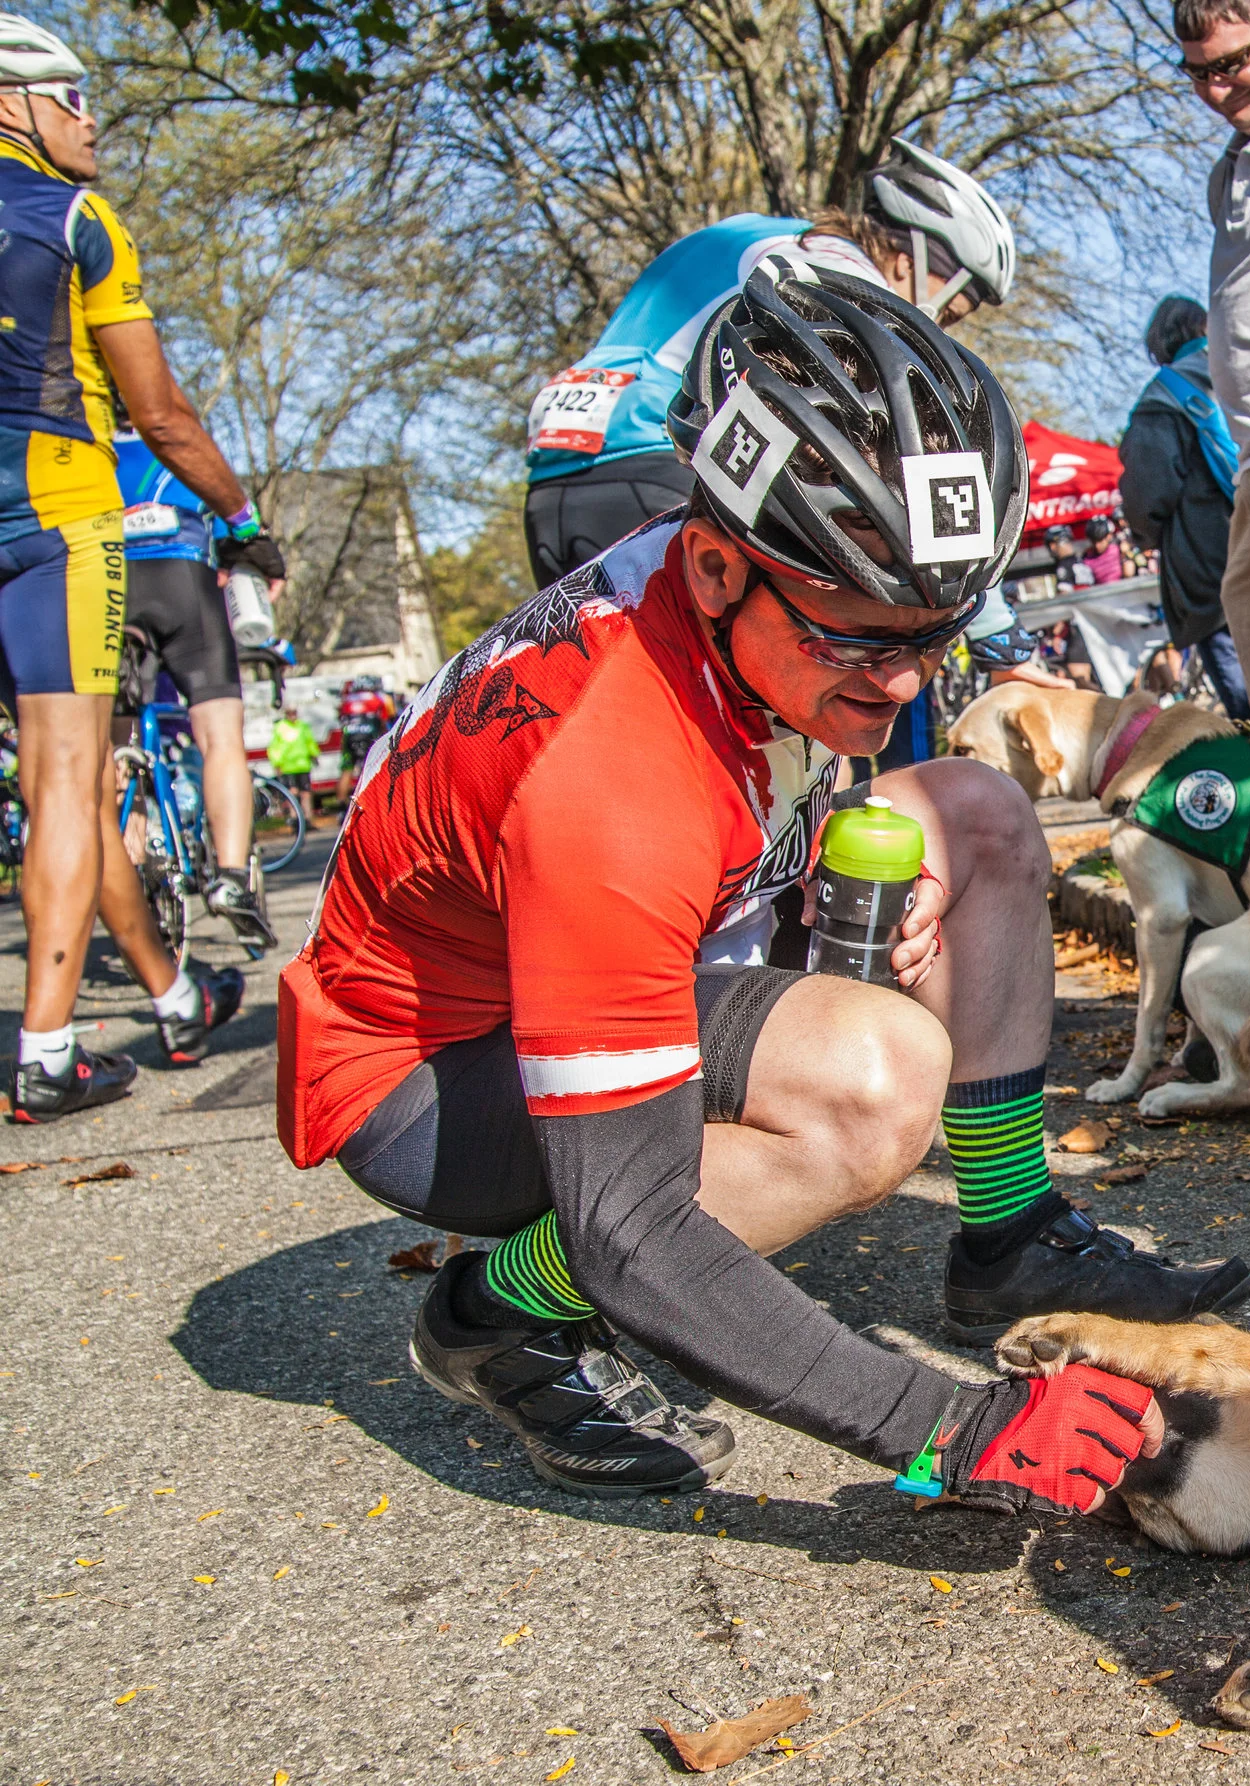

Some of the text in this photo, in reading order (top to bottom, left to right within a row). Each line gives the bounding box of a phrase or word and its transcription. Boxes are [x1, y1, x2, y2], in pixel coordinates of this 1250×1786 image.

[543, 389, 597, 412] 2422
[101, 541, 124, 581] BOB
[104, 587, 124, 653] DANCE
[525, 1436, 638, 1472] SPECIALIZED
